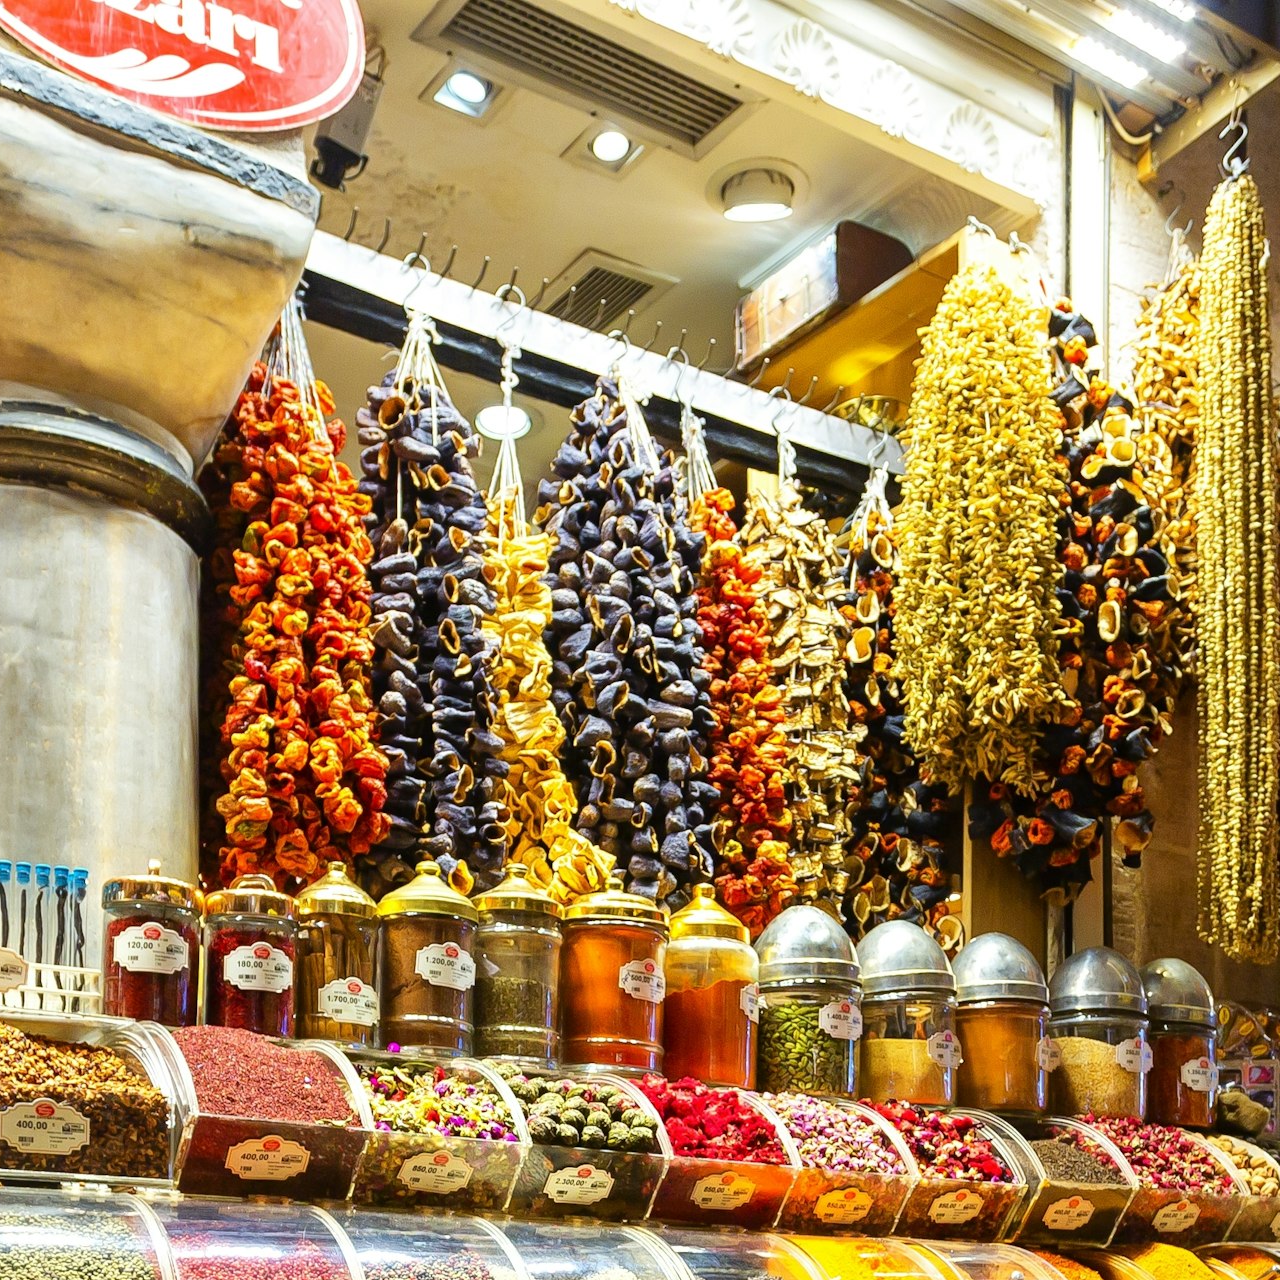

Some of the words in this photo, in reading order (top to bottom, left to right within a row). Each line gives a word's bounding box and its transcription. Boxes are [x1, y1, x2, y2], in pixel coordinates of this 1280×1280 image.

[98, 0, 284, 73] arı
[126, 941, 154, 951] 120,00
[236, 959, 264, 969] 180,00
[15, 1120, 48, 1132] 400,00
[240, 1152, 270, 1162] 400,00
